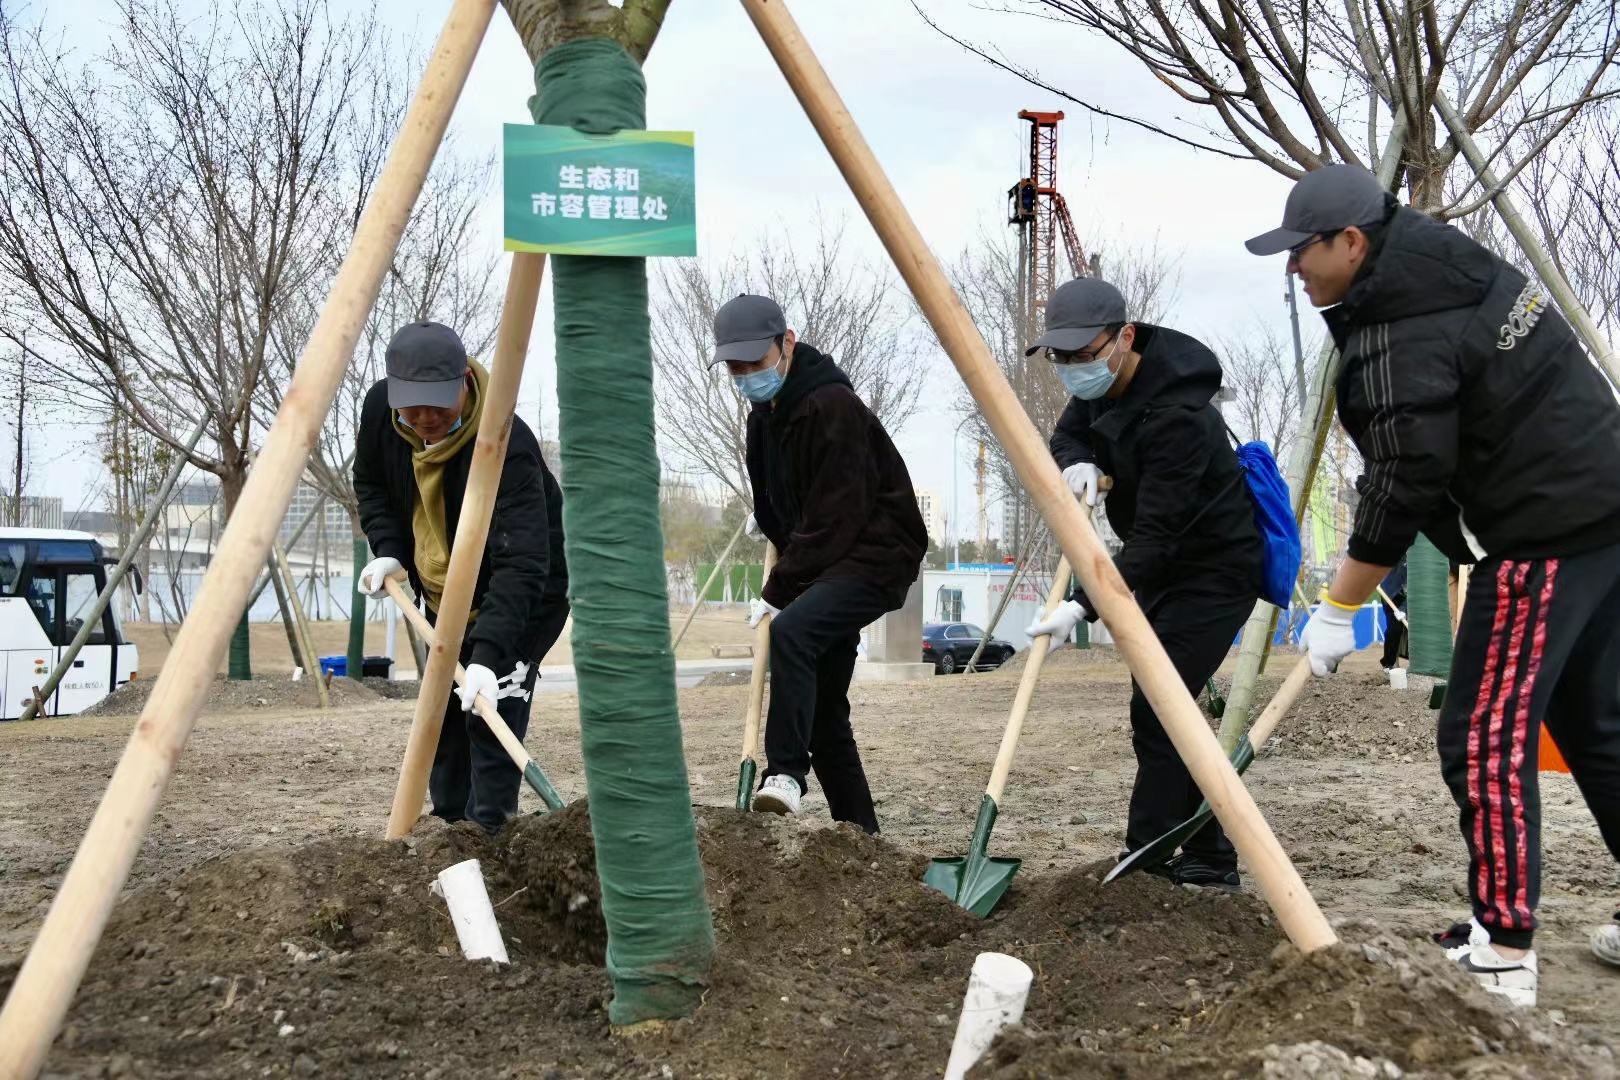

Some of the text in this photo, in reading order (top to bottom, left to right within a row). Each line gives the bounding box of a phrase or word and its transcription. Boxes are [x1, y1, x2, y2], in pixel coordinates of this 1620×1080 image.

[559, 165, 639, 191] 生态和
[531, 192, 668, 221] 市容管理处
